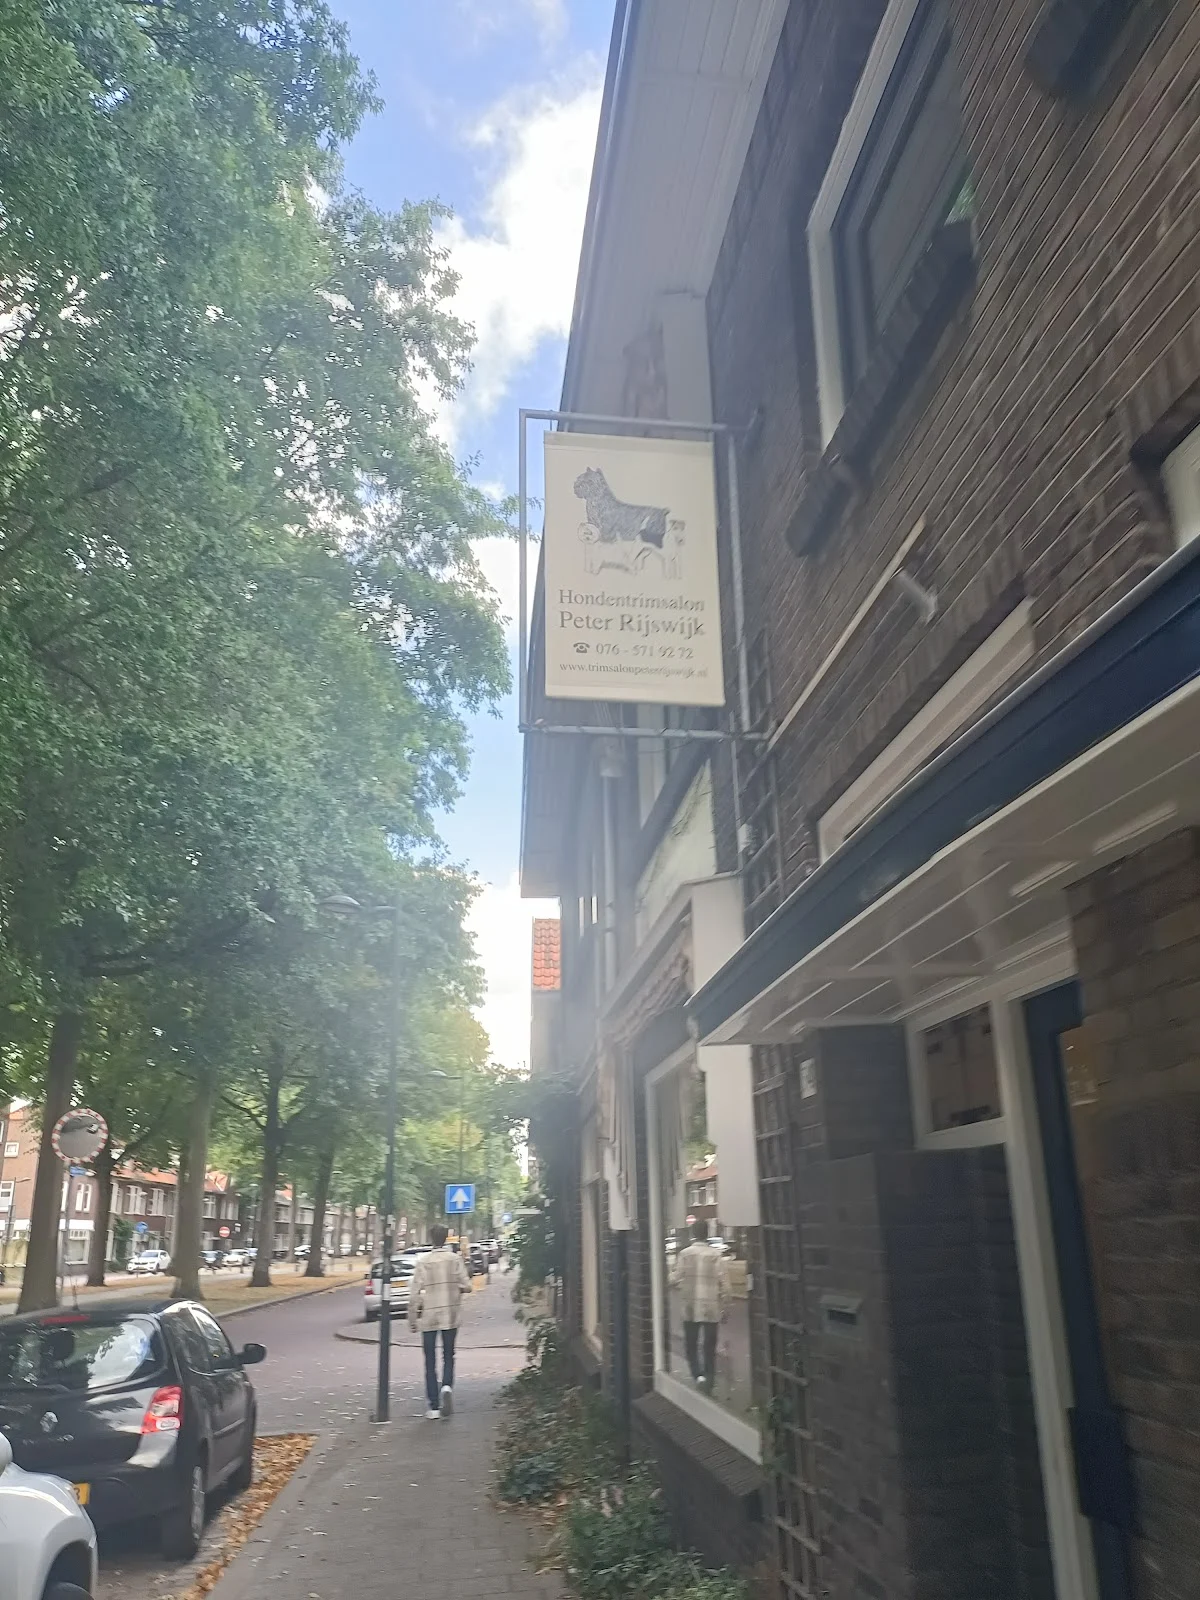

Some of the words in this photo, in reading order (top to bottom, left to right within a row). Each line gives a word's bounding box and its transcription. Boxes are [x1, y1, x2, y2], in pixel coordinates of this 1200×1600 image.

[559, 589, 705, 611] Hondentrimsalon
[560, 611, 613, 631] Peter
[619, 613, 705, 640] Rijswijk
[595, 643, 620, 656] 076
[632, 644, 654, 657] 571
